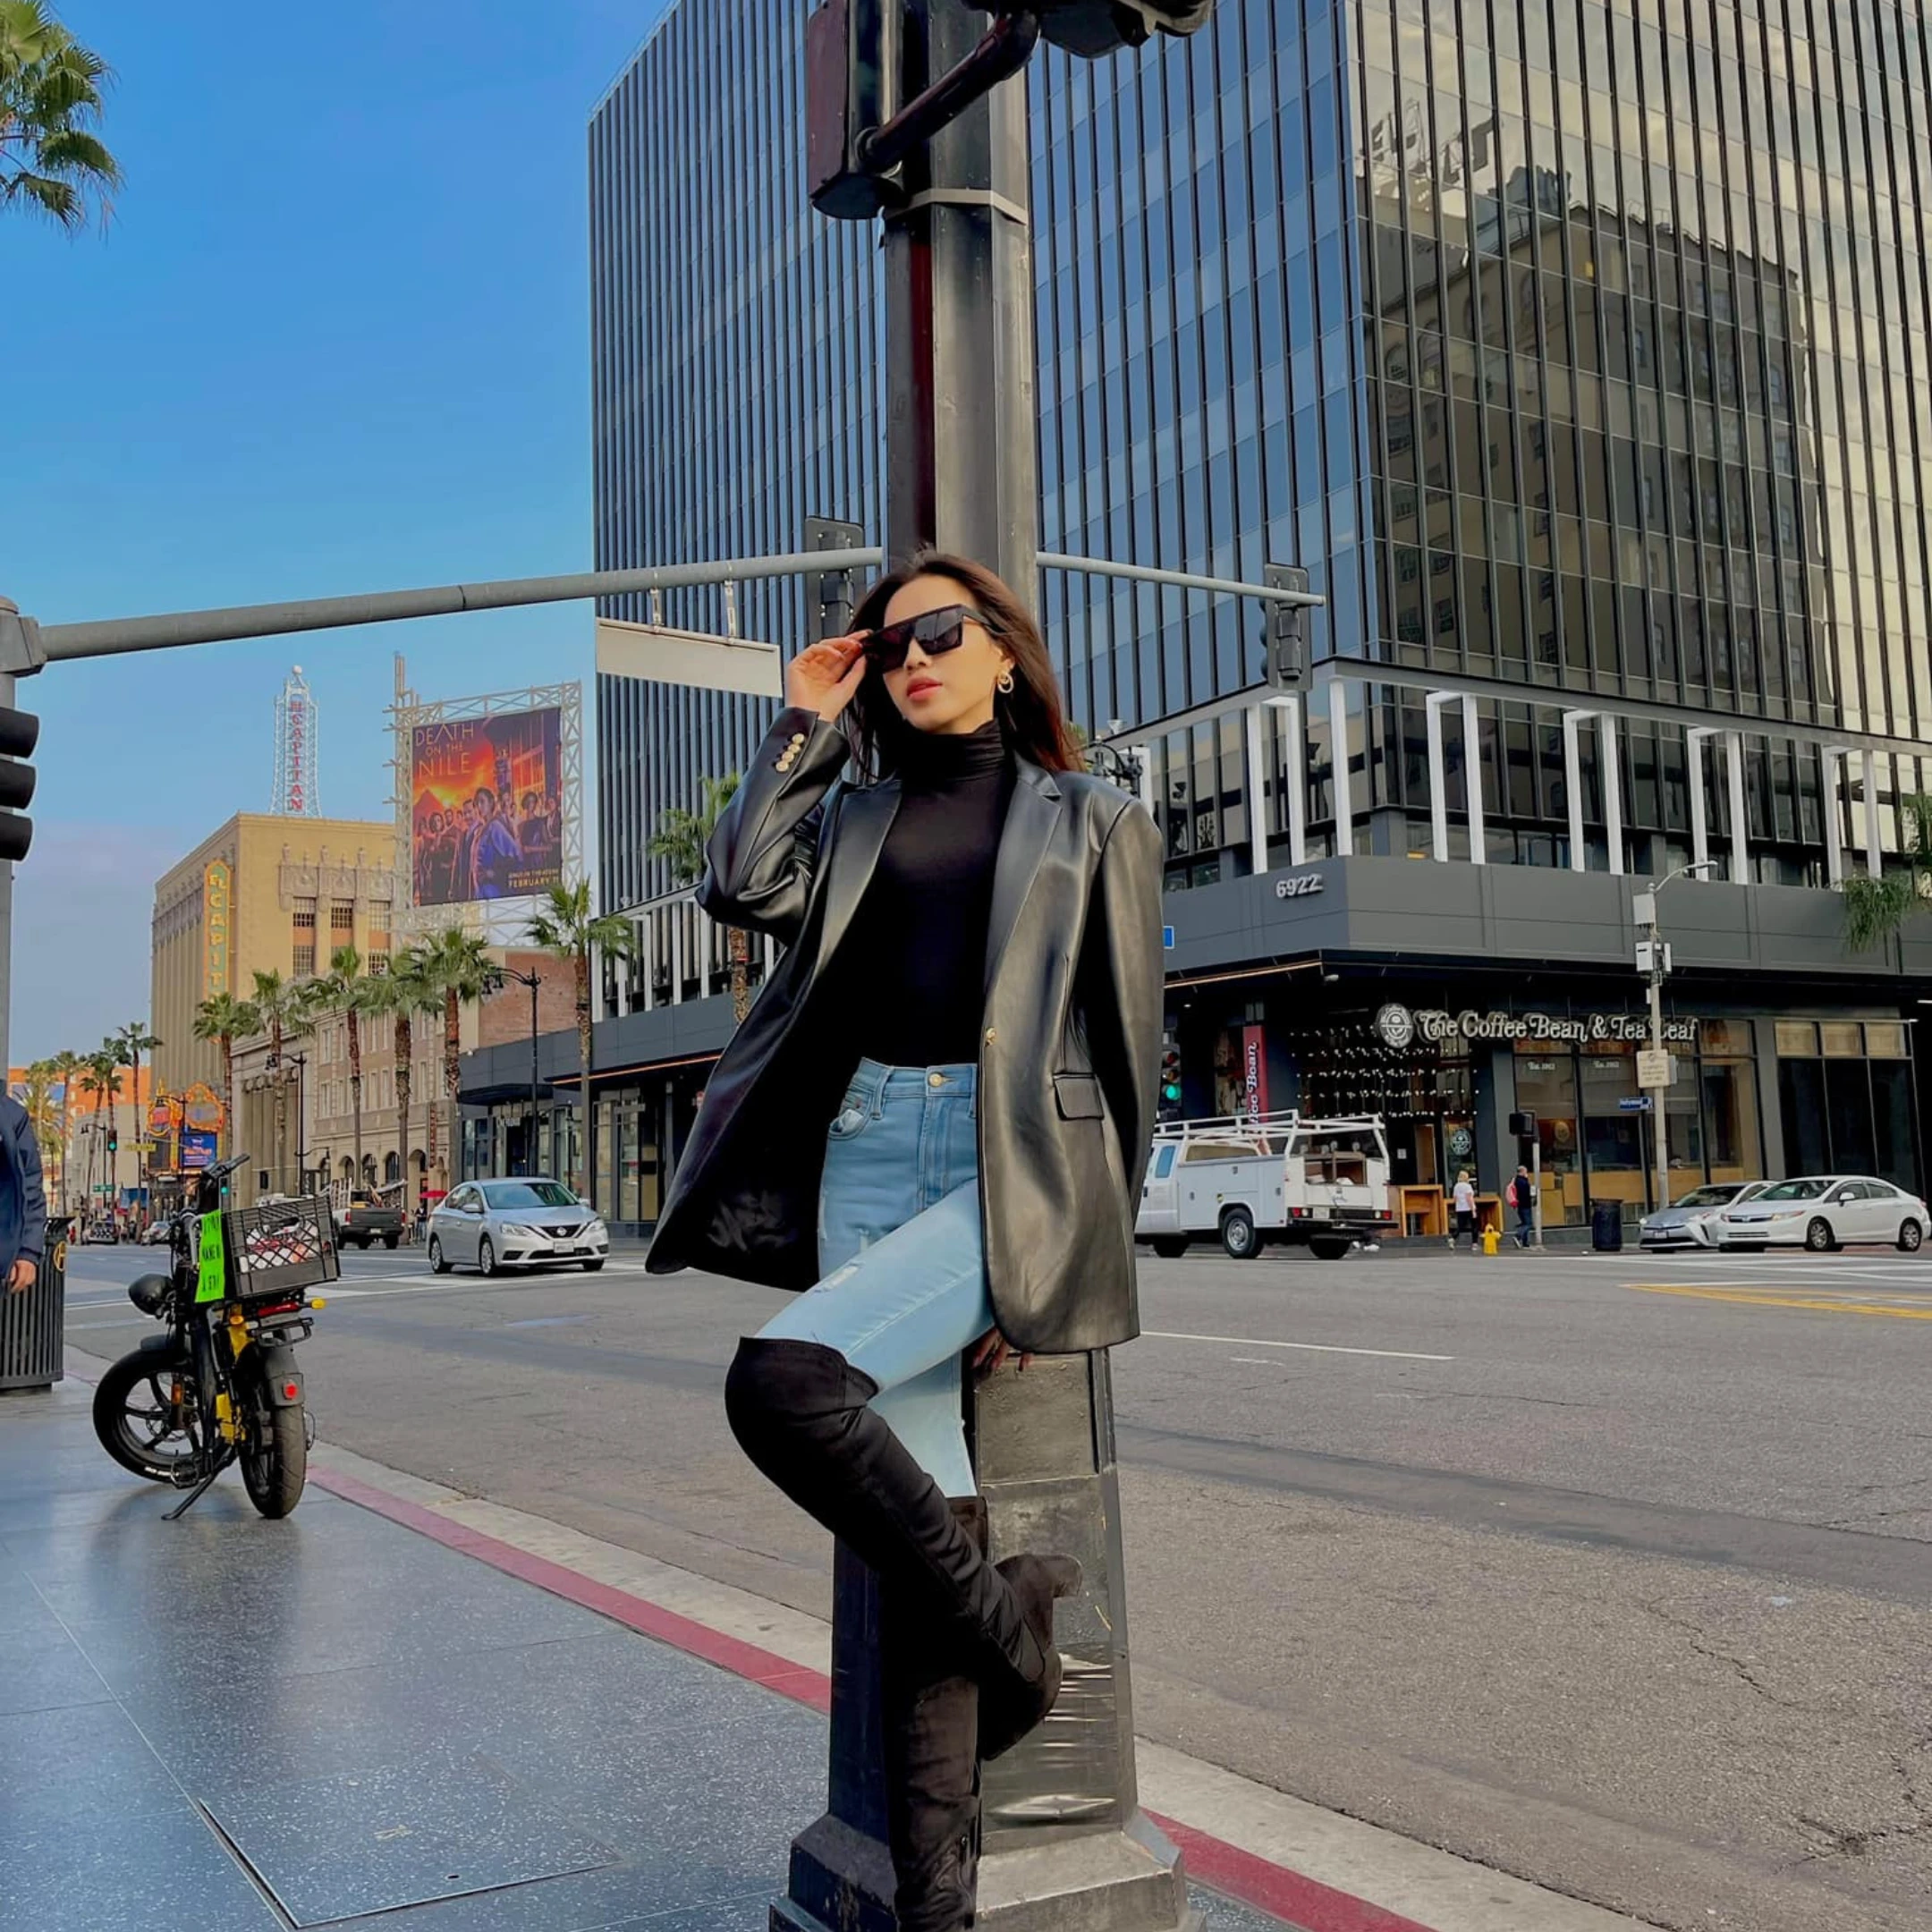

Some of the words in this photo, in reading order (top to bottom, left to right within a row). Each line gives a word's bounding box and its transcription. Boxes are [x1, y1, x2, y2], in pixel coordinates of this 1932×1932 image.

[416, 724, 474, 746] DEATH
[425, 744, 441, 758] ON
[446, 741, 463, 754] THE
[291, 714, 303, 811] CAPITAN
[419, 753, 471, 779] NILE
[508, 877, 549, 888] FEBRUARY
[1275, 873, 1323, 898] 6922
[1419, 1012, 1459, 1041] The
[1462, 1012, 1527, 1038] Coffee
[1529, 1014, 1589, 1043] Bean
[1592, 1015, 1609, 1039] &
[1611, 1015, 1647, 1040] Tea
